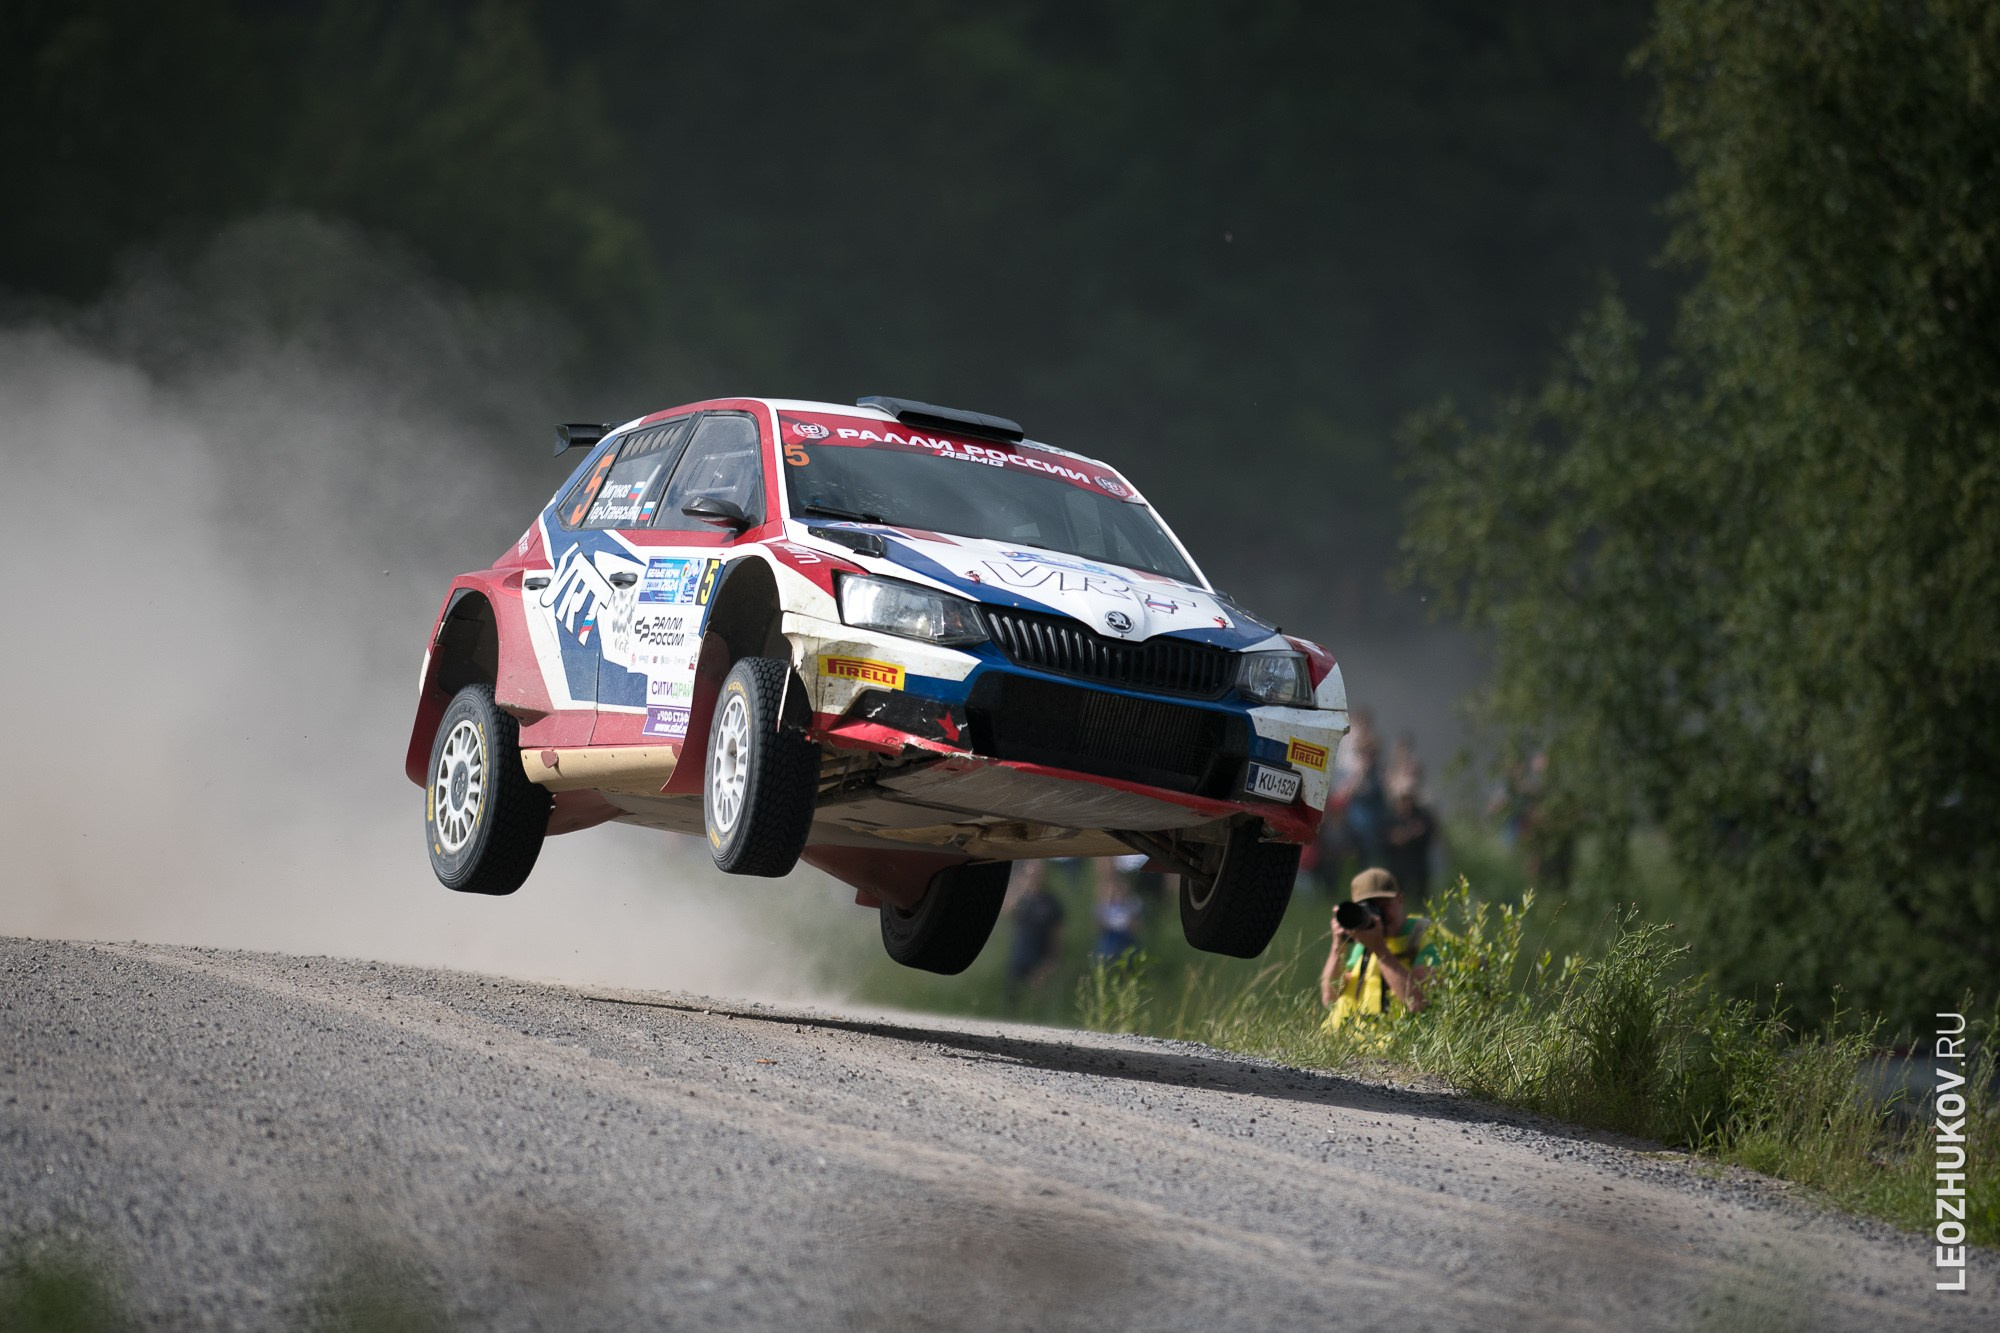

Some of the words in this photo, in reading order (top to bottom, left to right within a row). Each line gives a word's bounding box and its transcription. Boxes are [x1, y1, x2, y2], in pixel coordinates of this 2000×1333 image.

[784, 445, 810, 467] 5
[836, 428, 955, 452] РАЛЛИ
[963, 444, 1091, 484] РОССИИ
[570, 454, 615, 525] 5
[540, 541, 614, 647] VRT
[701, 559, 720, 605] 5
[652, 616, 683, 630] РАЛЛИ
[648, 632, 685, 646] РОССИИ
[827, 658, 898, 685] PIRELLI
[651, 680, 694, 699] СИТИДРАЙ
[1290, 741, 1326, 768] PIRELLI
[1259, 771, 1297, 797] KU-1529
